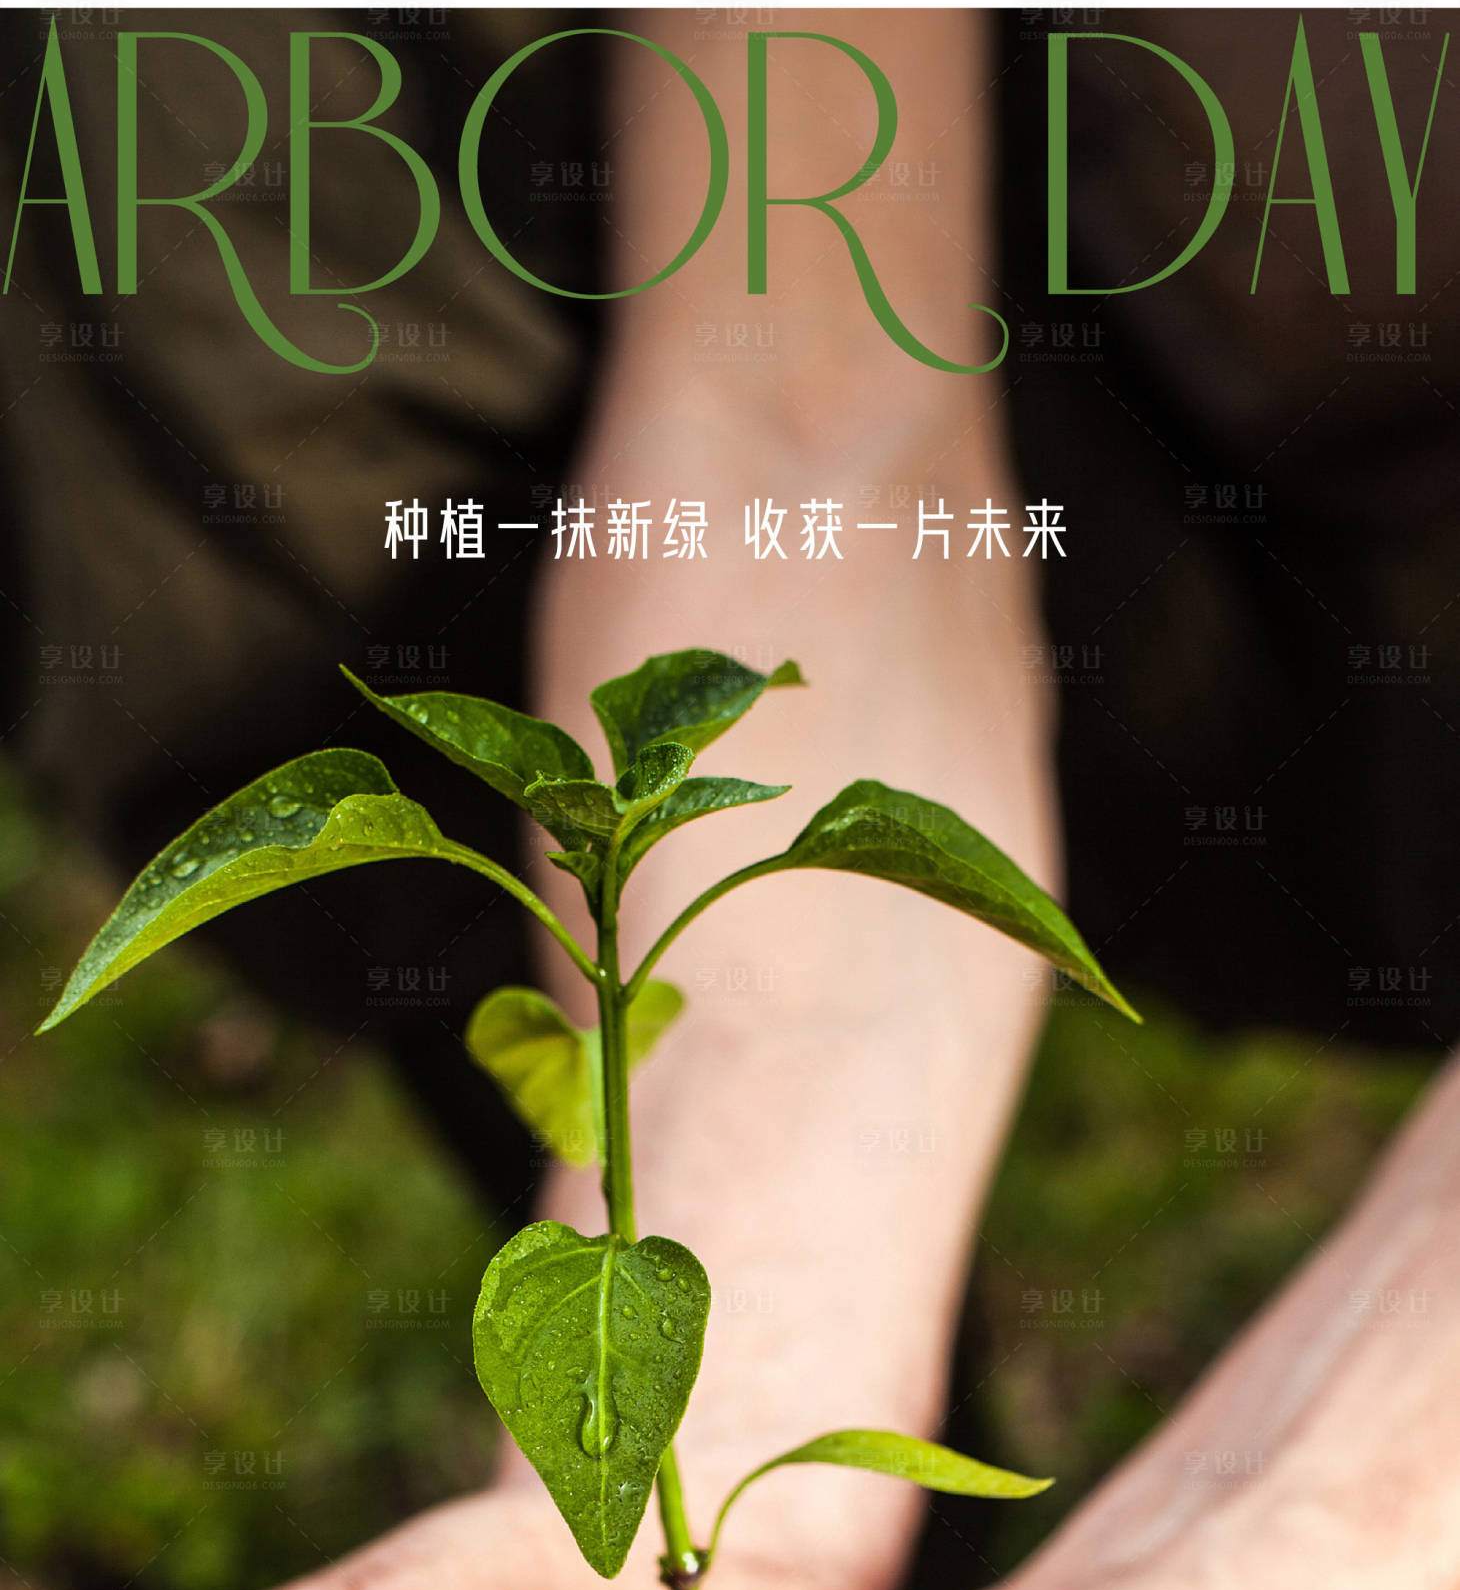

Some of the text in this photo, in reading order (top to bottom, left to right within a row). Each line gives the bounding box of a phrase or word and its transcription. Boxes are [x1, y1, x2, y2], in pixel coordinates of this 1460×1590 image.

[4, 14, 1449, 373] ARBOR DAY
[385, 497, 1067, 559] 种植一抹新绿 收获一片未来
